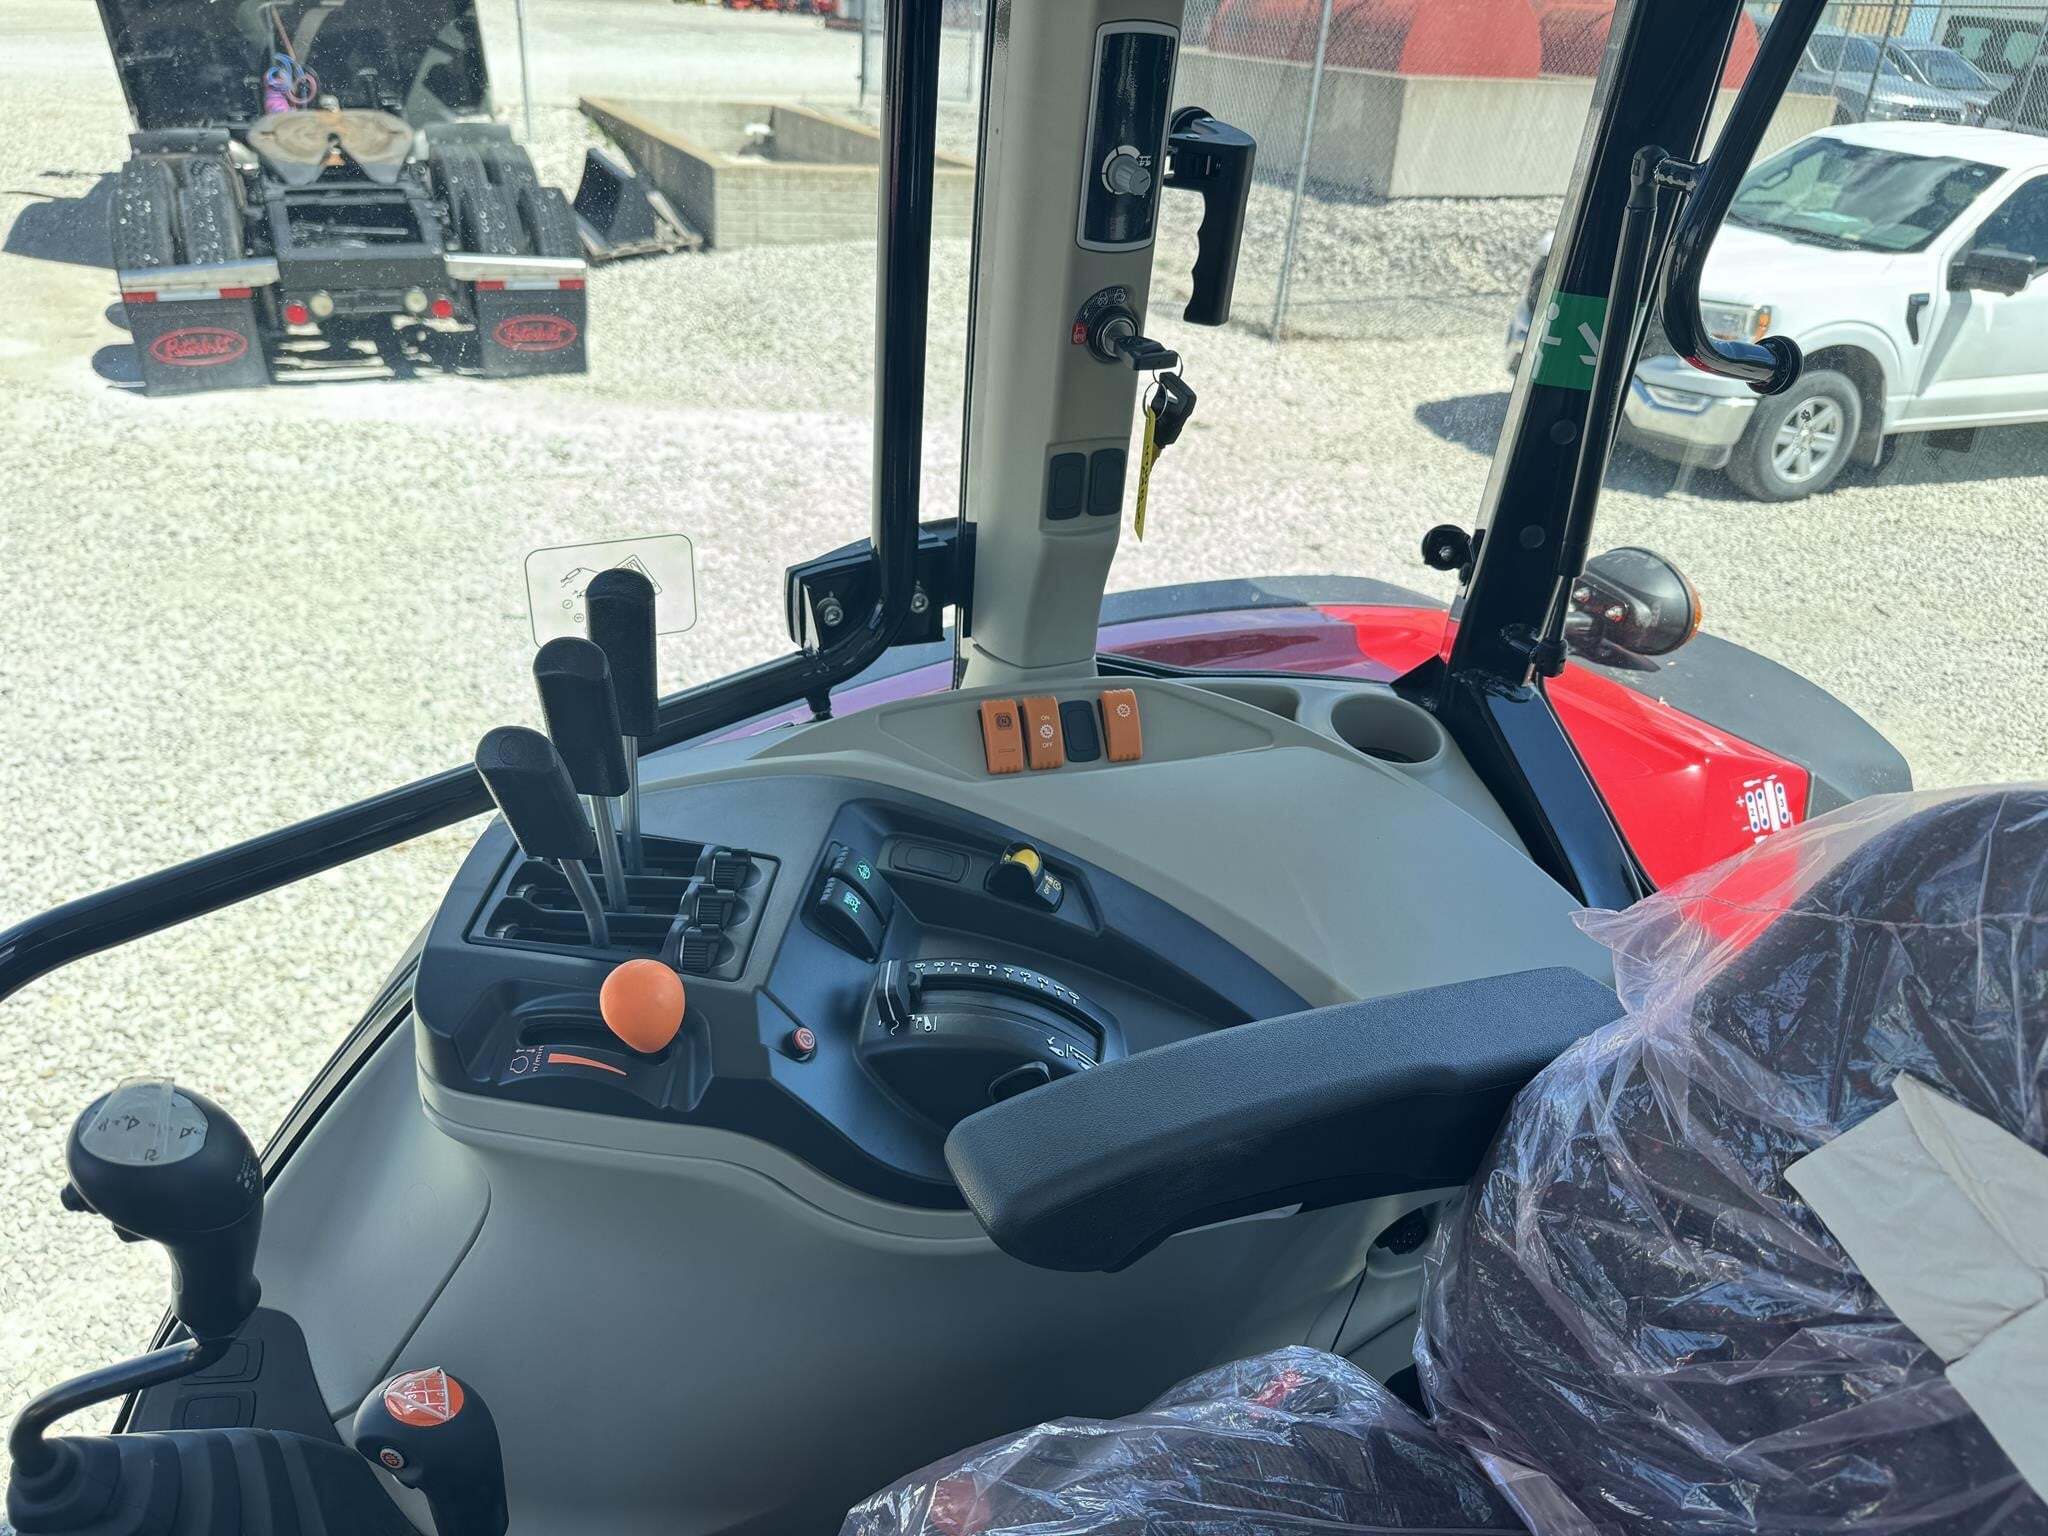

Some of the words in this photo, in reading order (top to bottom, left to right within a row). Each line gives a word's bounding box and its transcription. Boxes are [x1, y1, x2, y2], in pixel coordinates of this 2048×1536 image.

[1003, 966, 1014, 974] 4
[1019, 970, 1031, 979] 3
[1037, 976, 1049, 986] 2
[1053, 984, 1065, 993] 1
[1068, 991, 1080, 1001] 0
[532, 1045, 544, 1072] n/min
